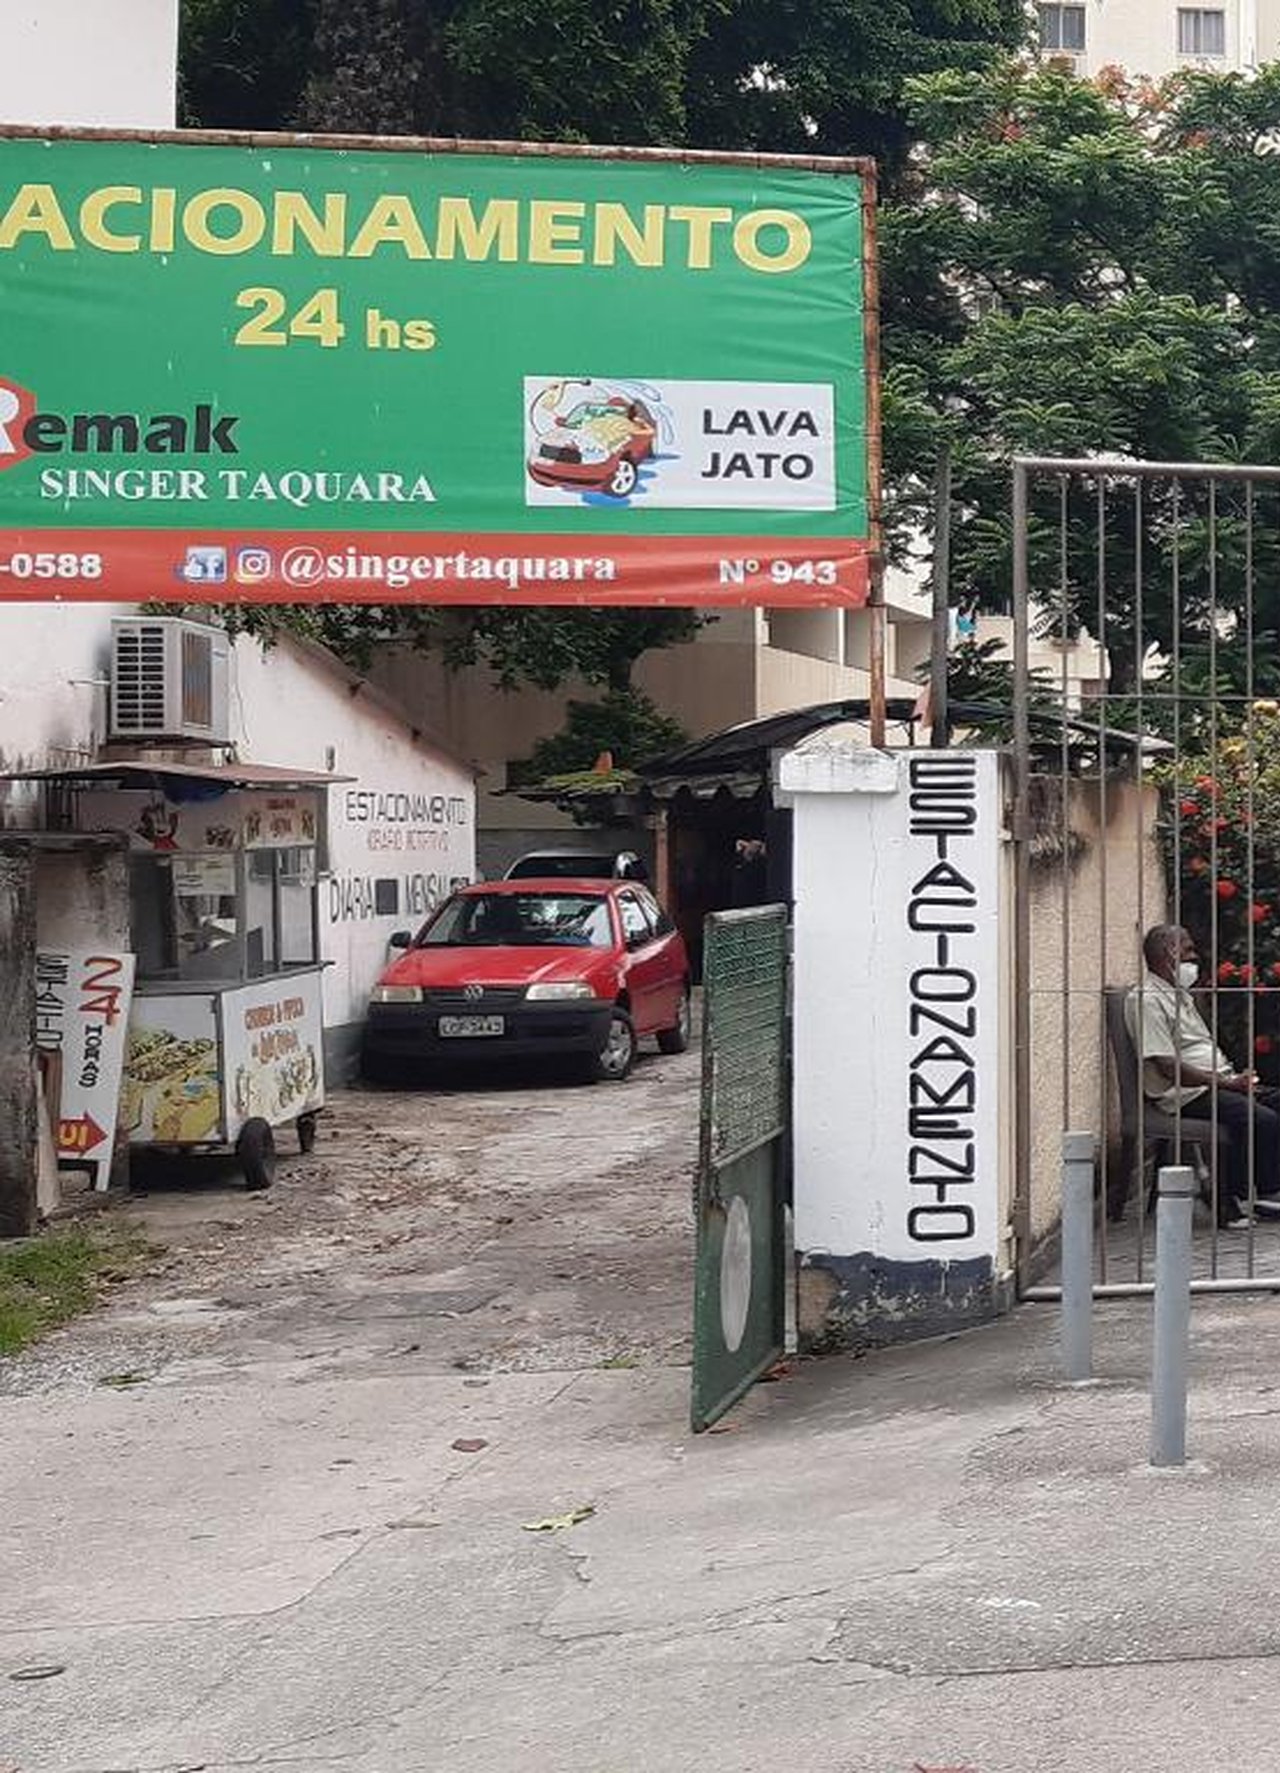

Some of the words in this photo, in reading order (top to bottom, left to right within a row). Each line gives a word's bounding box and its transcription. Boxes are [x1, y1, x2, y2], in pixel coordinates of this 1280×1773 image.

[0, 184, 812, 273] ACIONAMENTO
[235, 287, 346, 348] 24
[366, 309, 437, 350] hs
[702, 409, 820, 438] LAVA
[40, 468, 209, 500] SINGER
[219, 470, 438, 508] TAQUARA
[701, 452, 814, 481] JATO
[281, 546, 617, 589] @singertaquara
[771, 560, 839, 586] 943
[78, 955, 123, 1026] 24
[907, 757, 978, 1242] ESTACIONAMENTO
